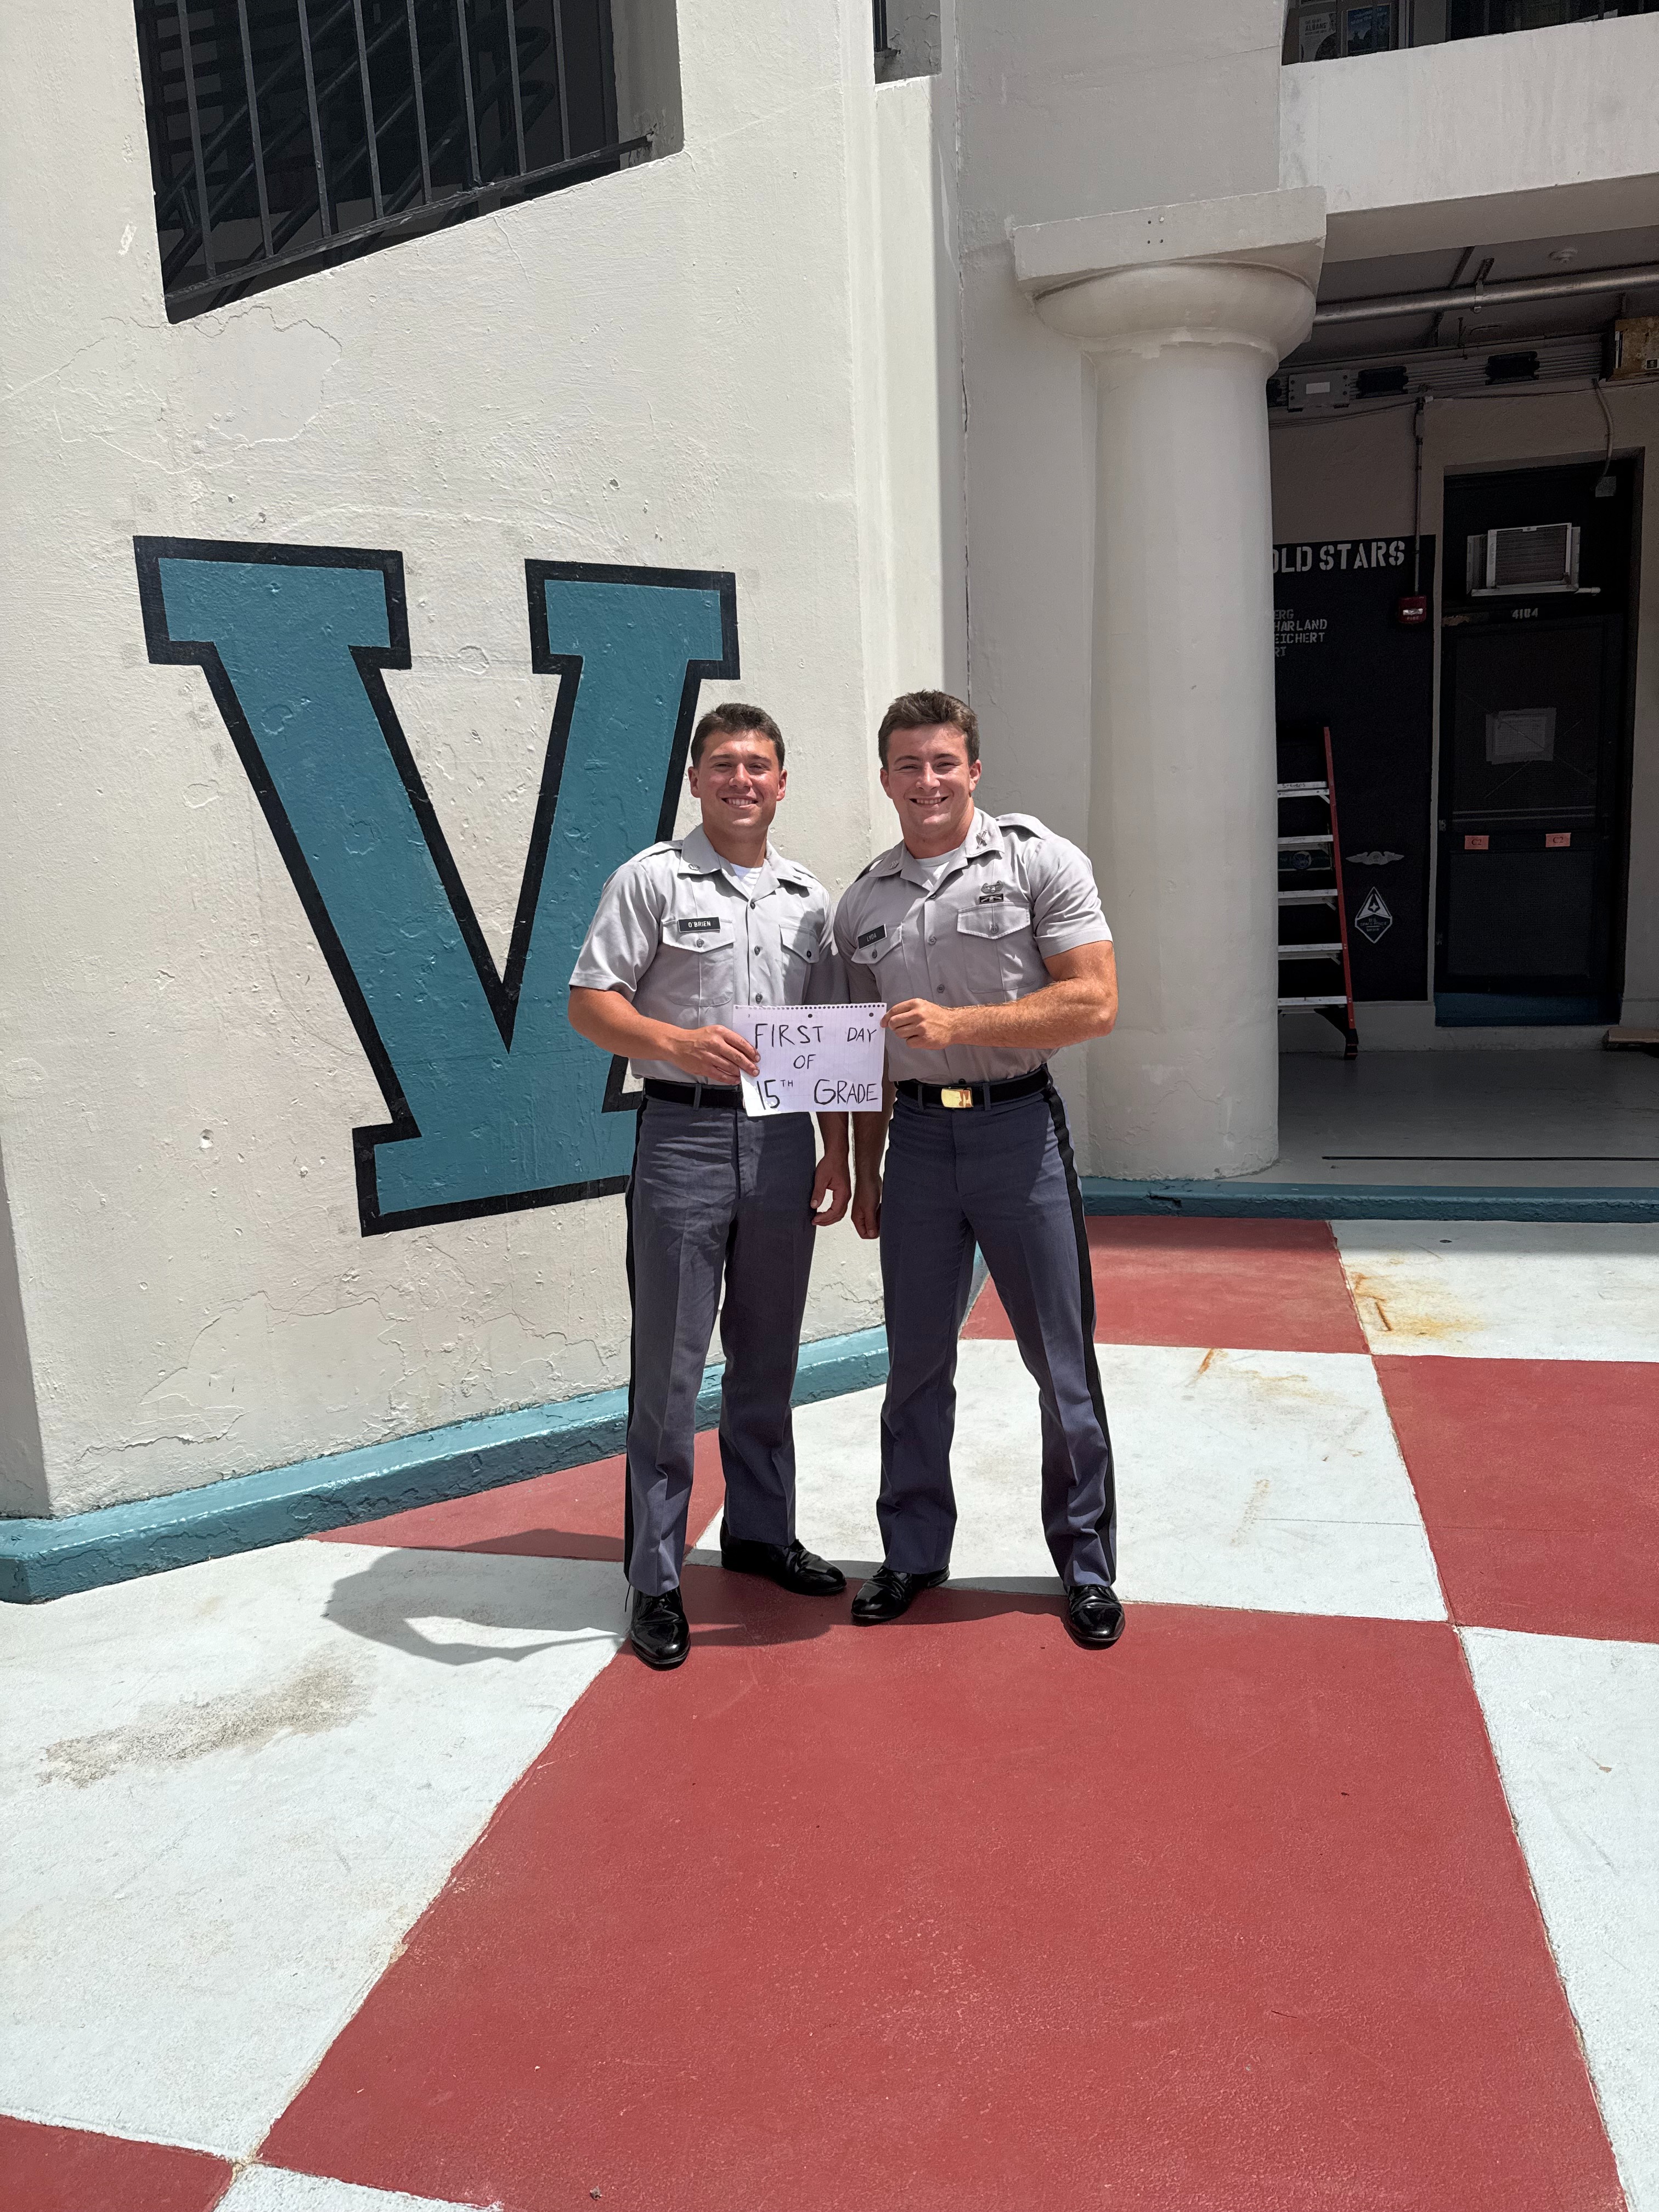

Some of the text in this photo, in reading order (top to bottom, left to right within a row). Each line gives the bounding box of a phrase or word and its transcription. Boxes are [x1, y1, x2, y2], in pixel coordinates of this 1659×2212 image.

[1319, 541, 1406, 571] STARS
[1471, 838, 1482, 846] C2
[755, 1023, 877, 1049] FIRST DAY
[793, 1054, 816, 1069] OF
[814, 1079, 878, 1105] GRADE
